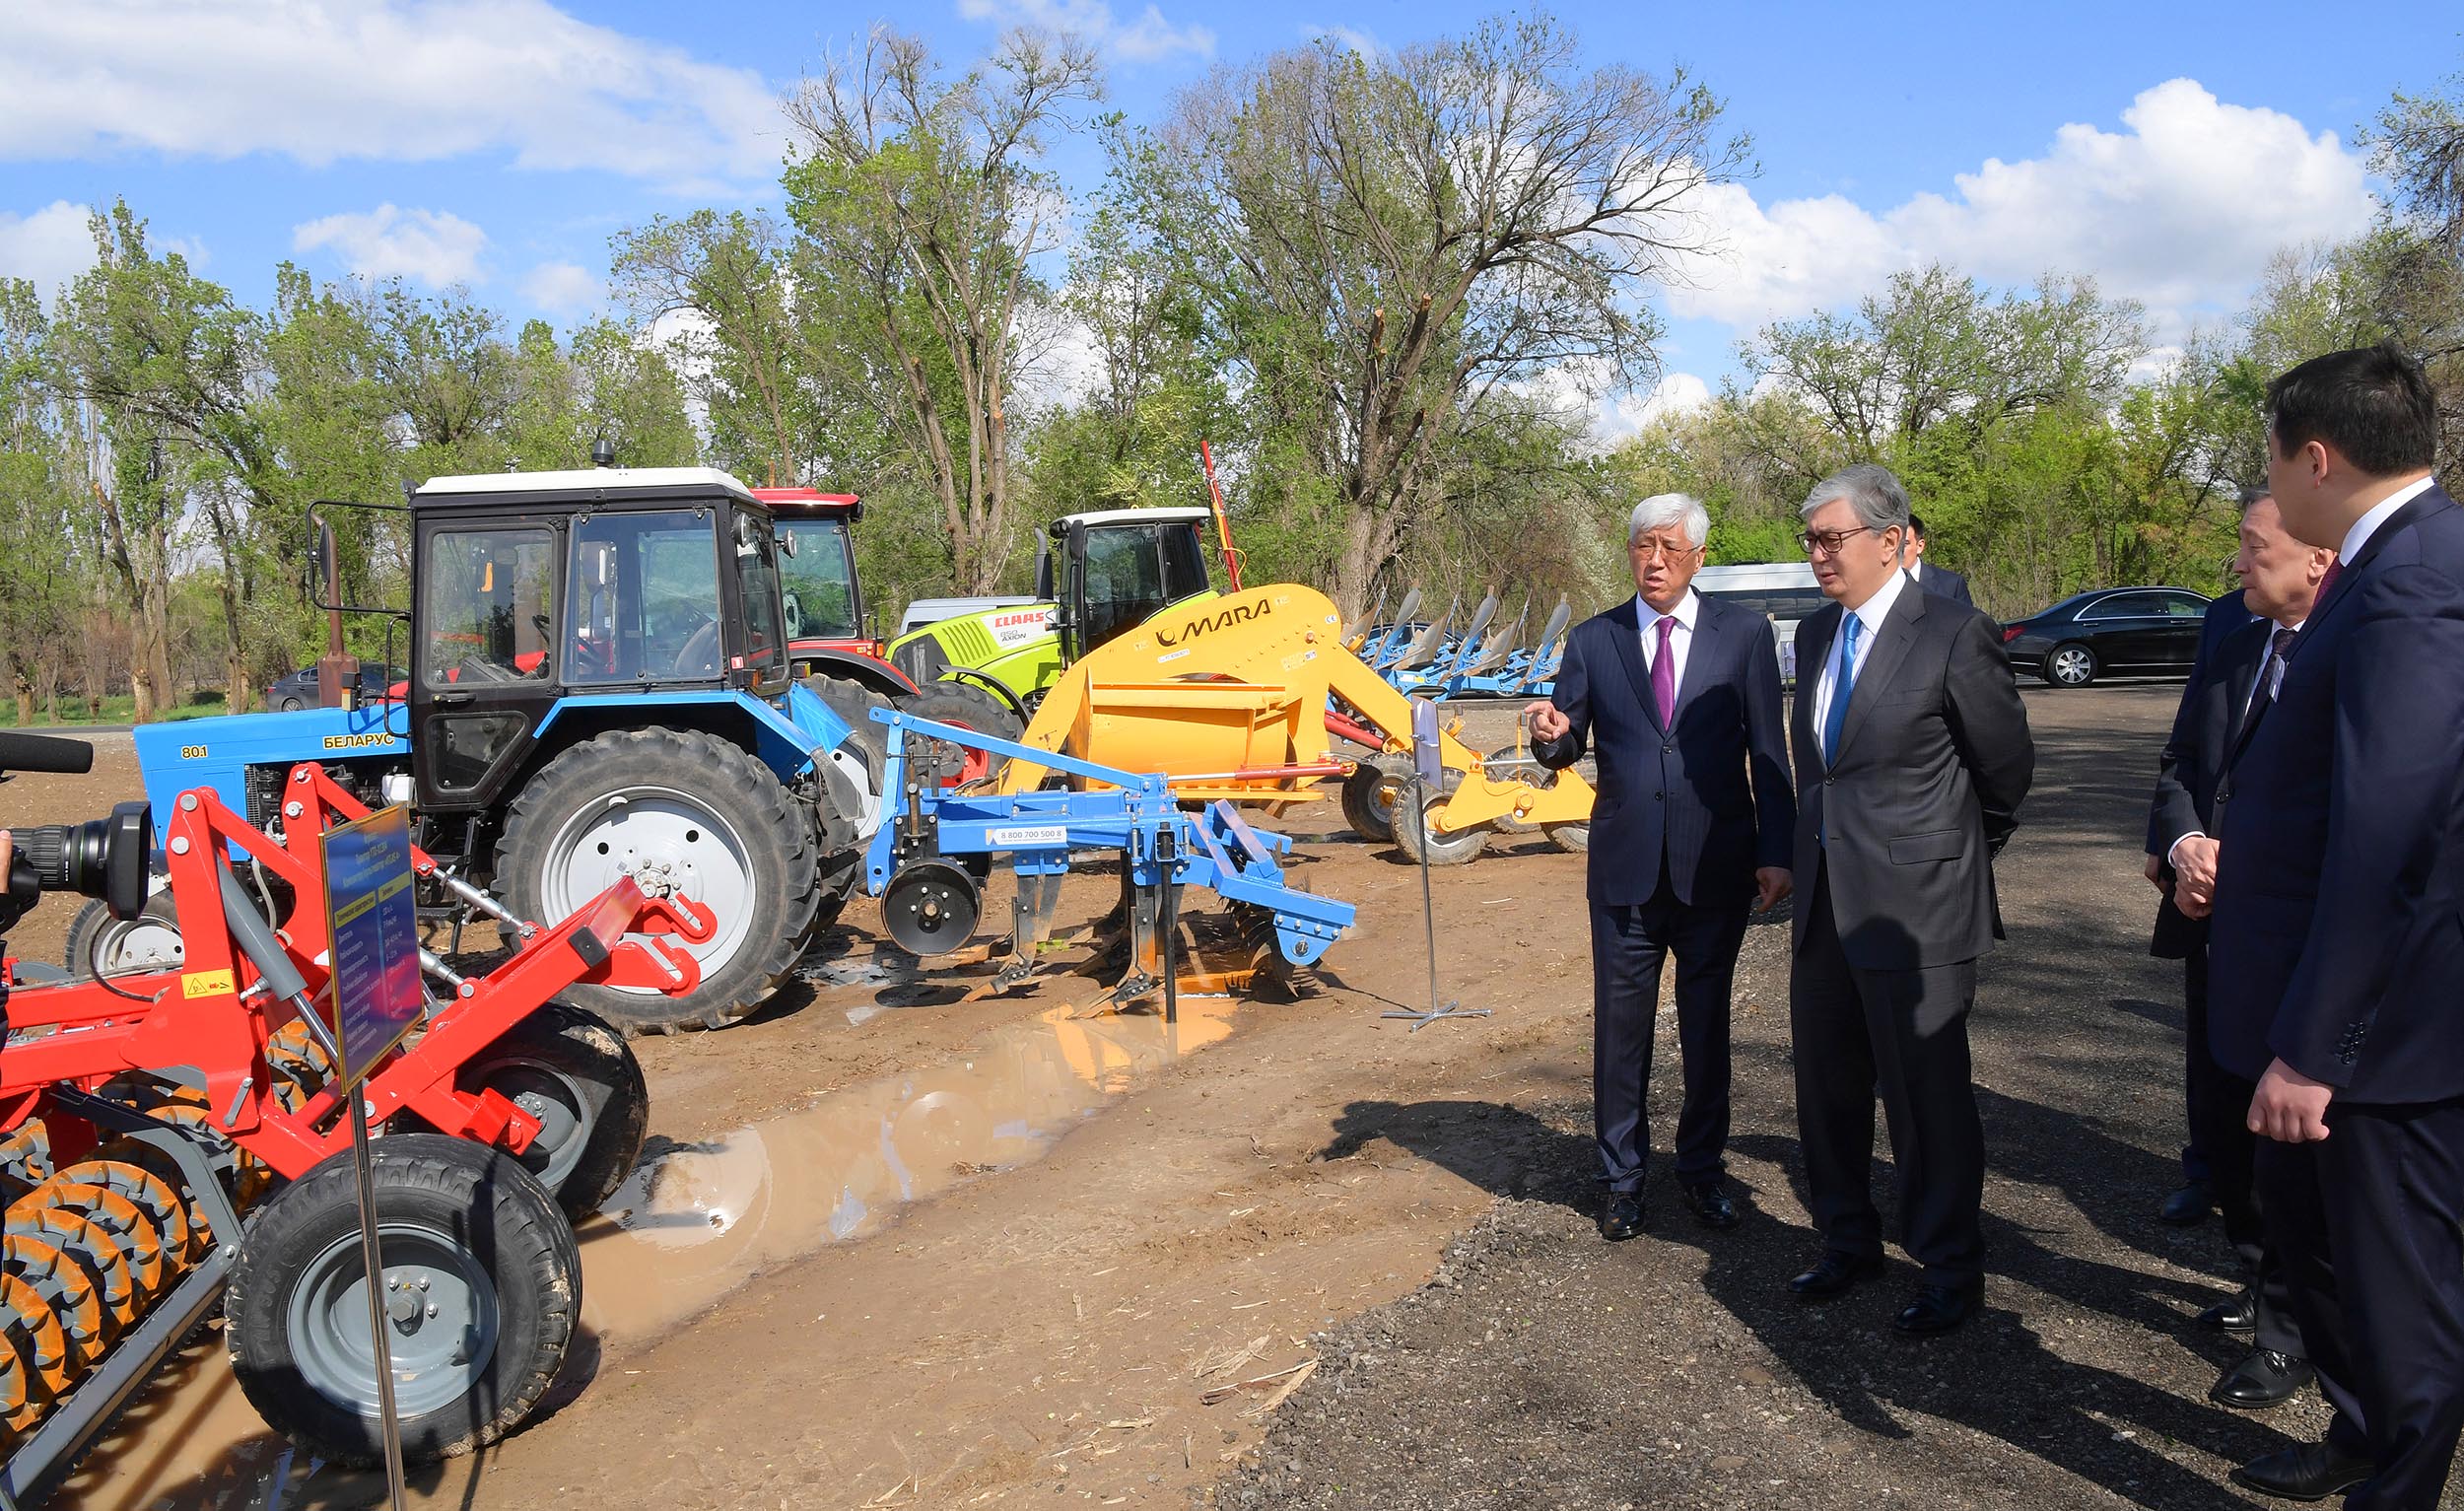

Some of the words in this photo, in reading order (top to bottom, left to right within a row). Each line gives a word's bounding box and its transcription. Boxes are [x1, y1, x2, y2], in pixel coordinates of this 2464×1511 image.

[994, 612, 1044, 628] CLAAS
[1182, 598, 1271, 642] MARA
[1001, 633, 1027, 642] AXION
[323, 732, 395, 749] БЕЛАРУС
